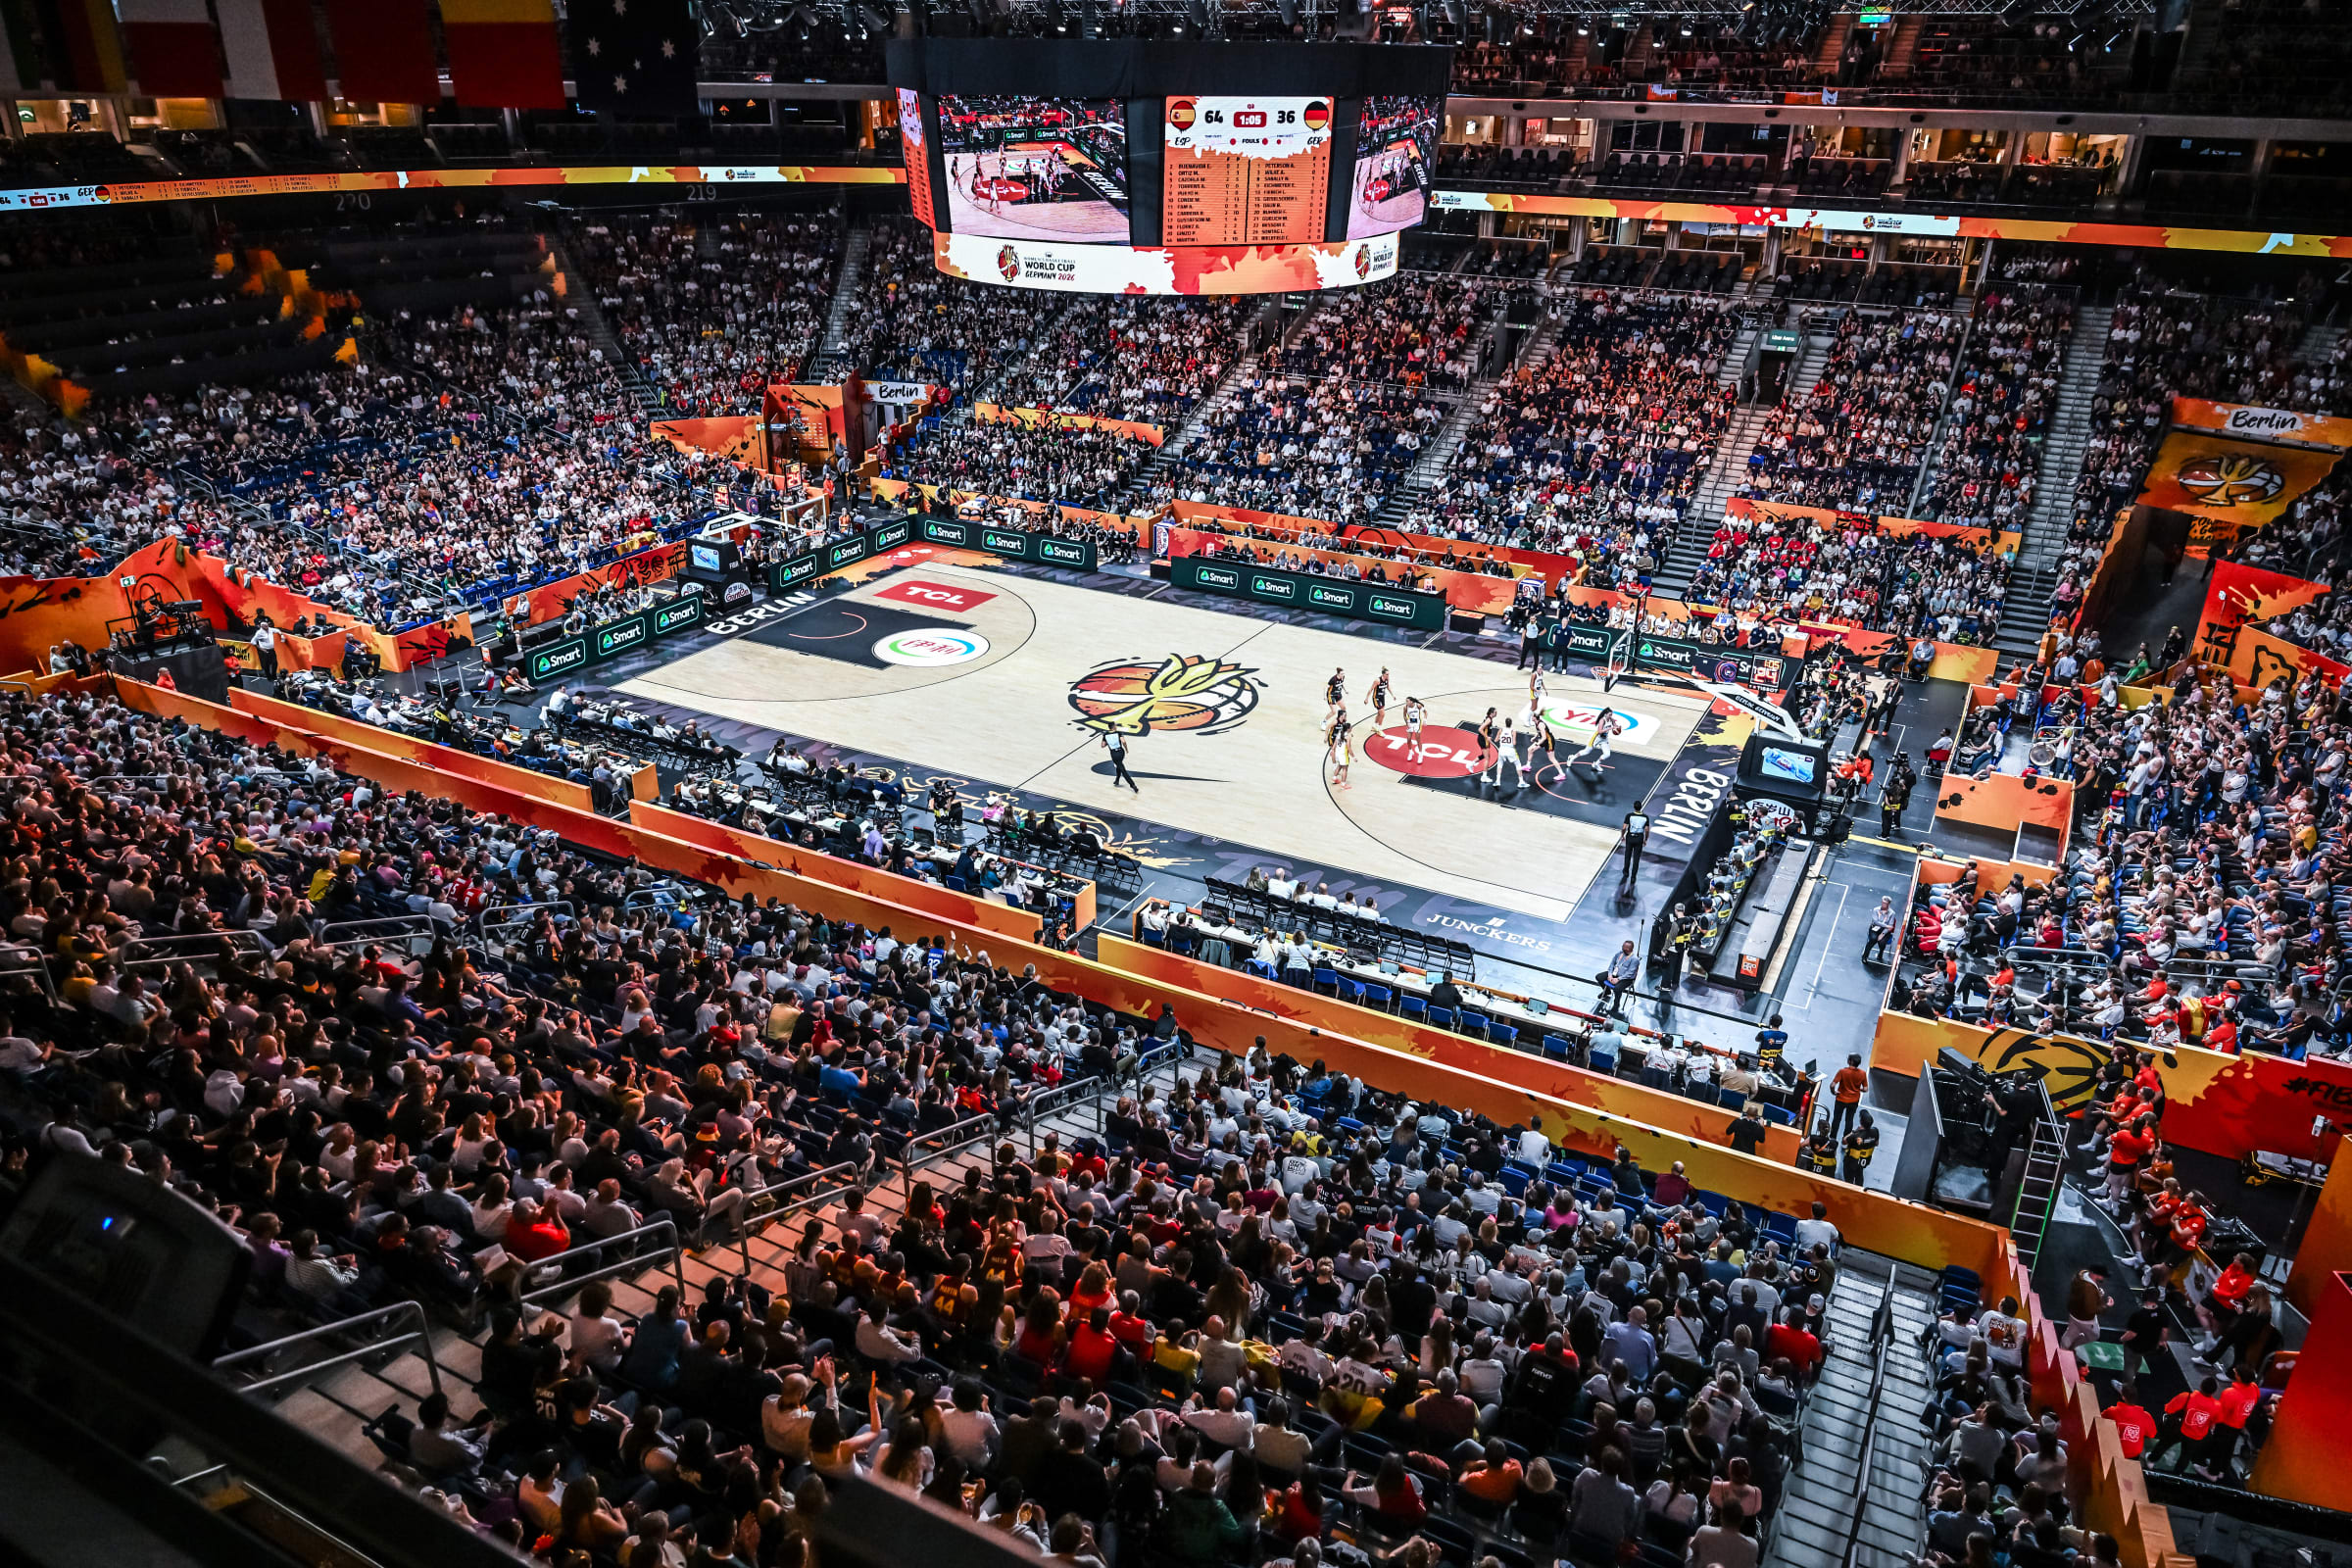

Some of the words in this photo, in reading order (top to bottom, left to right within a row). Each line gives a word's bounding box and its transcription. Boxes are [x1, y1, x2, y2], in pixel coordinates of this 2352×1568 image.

[1204, 110, 1223, 123] 64
[1239, 115, 1261, 125] 1:05
[1277, 110, 1296, 123] 36
[1174, 136, 1191, 146] ESP
[77, 187, 94, 196] GER
[687, 184, 716, 201] 219
[1084, 172, 1128, 200] BERLIN
[1024, 261, 1055, 270] WORLD
[1056, 263, 1075, 271] CUP
[1025, 270, 1056, 279] GERMANY
[1057, 272, 1075, 281] 2026
[879, 385, 918, 398] Berlin
[2231, 410, 2297, 430] Berlin
[786, 472, 800, 488] 24
[713, 493, 729, 506] 24
[886, 528, 906, 543] Smart
[937, 527, 961, 540] Smart
[996, 536, 1021, 550] Smart
[841, 544, 861, 559] Smart
[1054, 546, 1080, 560] Smart
[791, 562, 813, 578] Smart
[1209, 573, 1234, 585] Smart
[1265, 581, 1291, 594] Smart
[906, 586, 964, 605] TCL
[1323, 592, 1349, 604] Smart
[669, 605, 695, 623] Smart
[705, 592, 816, 635] BERLIN
[1384, 602, 1410, 614] Smart
[612, 624, 641, 644] Smart
[550, 647, 581, 667] Smart
[1653, 648, 1690, 663] Smart
[1764, 660, 1780, 669] 1:05
[1754, 667, 1778, 684] 24
[1758, 684, 1779, 693] TISSOT
[1501, 736, 1512, 745] 20
[1383, 734, 1480, 766] TCL
[1649, 768, 1730, 844] BERLIN
[1427, 913, 1551, 951] JUNCKERS
[986, 1267, 1006, 1282] 44
[940, 1285, 957, 1297] MARTIN
[934, 1295, 956, 1317] 44
[1532, 1367, 1553, 1380] FOREVER
[1341, 1372, 1366, 1395] 20
[536, 1398, 557, 1420] 20
